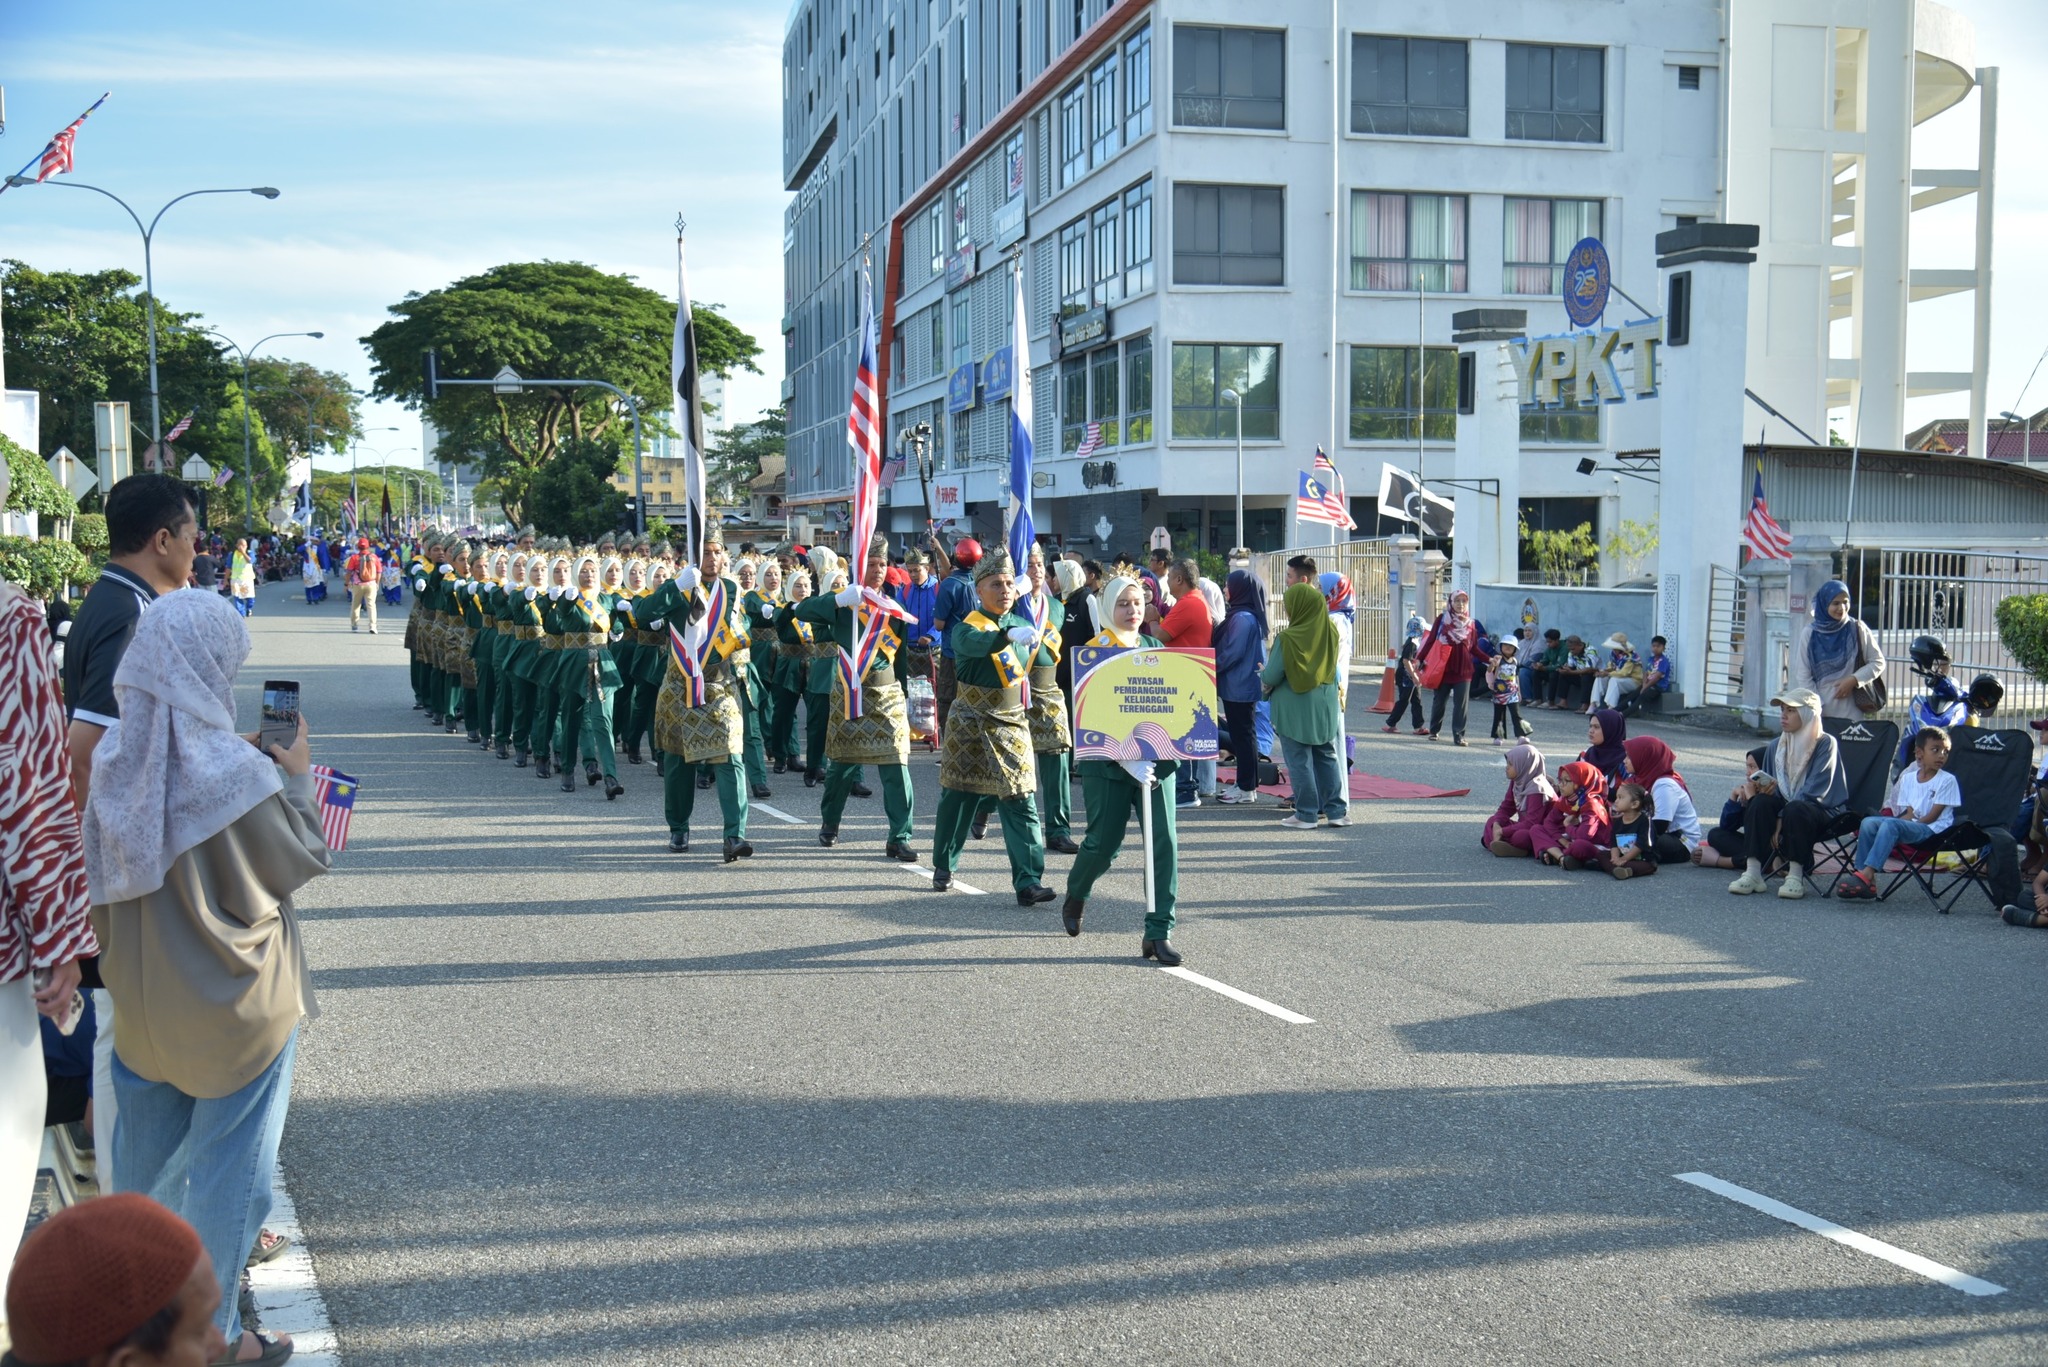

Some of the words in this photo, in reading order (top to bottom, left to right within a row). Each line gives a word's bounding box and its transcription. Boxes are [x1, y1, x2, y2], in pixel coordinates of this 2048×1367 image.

[1507, 316, 1663, 409] YPKT
[1127, 677, 1164, 685] YAYASAN
[1114, 686, 1178, 695] PEMBANGUNAN
[1124, 696, 1168, 704] KELUARGA
[1118, 705, 1174, 713] TERENGGANU
